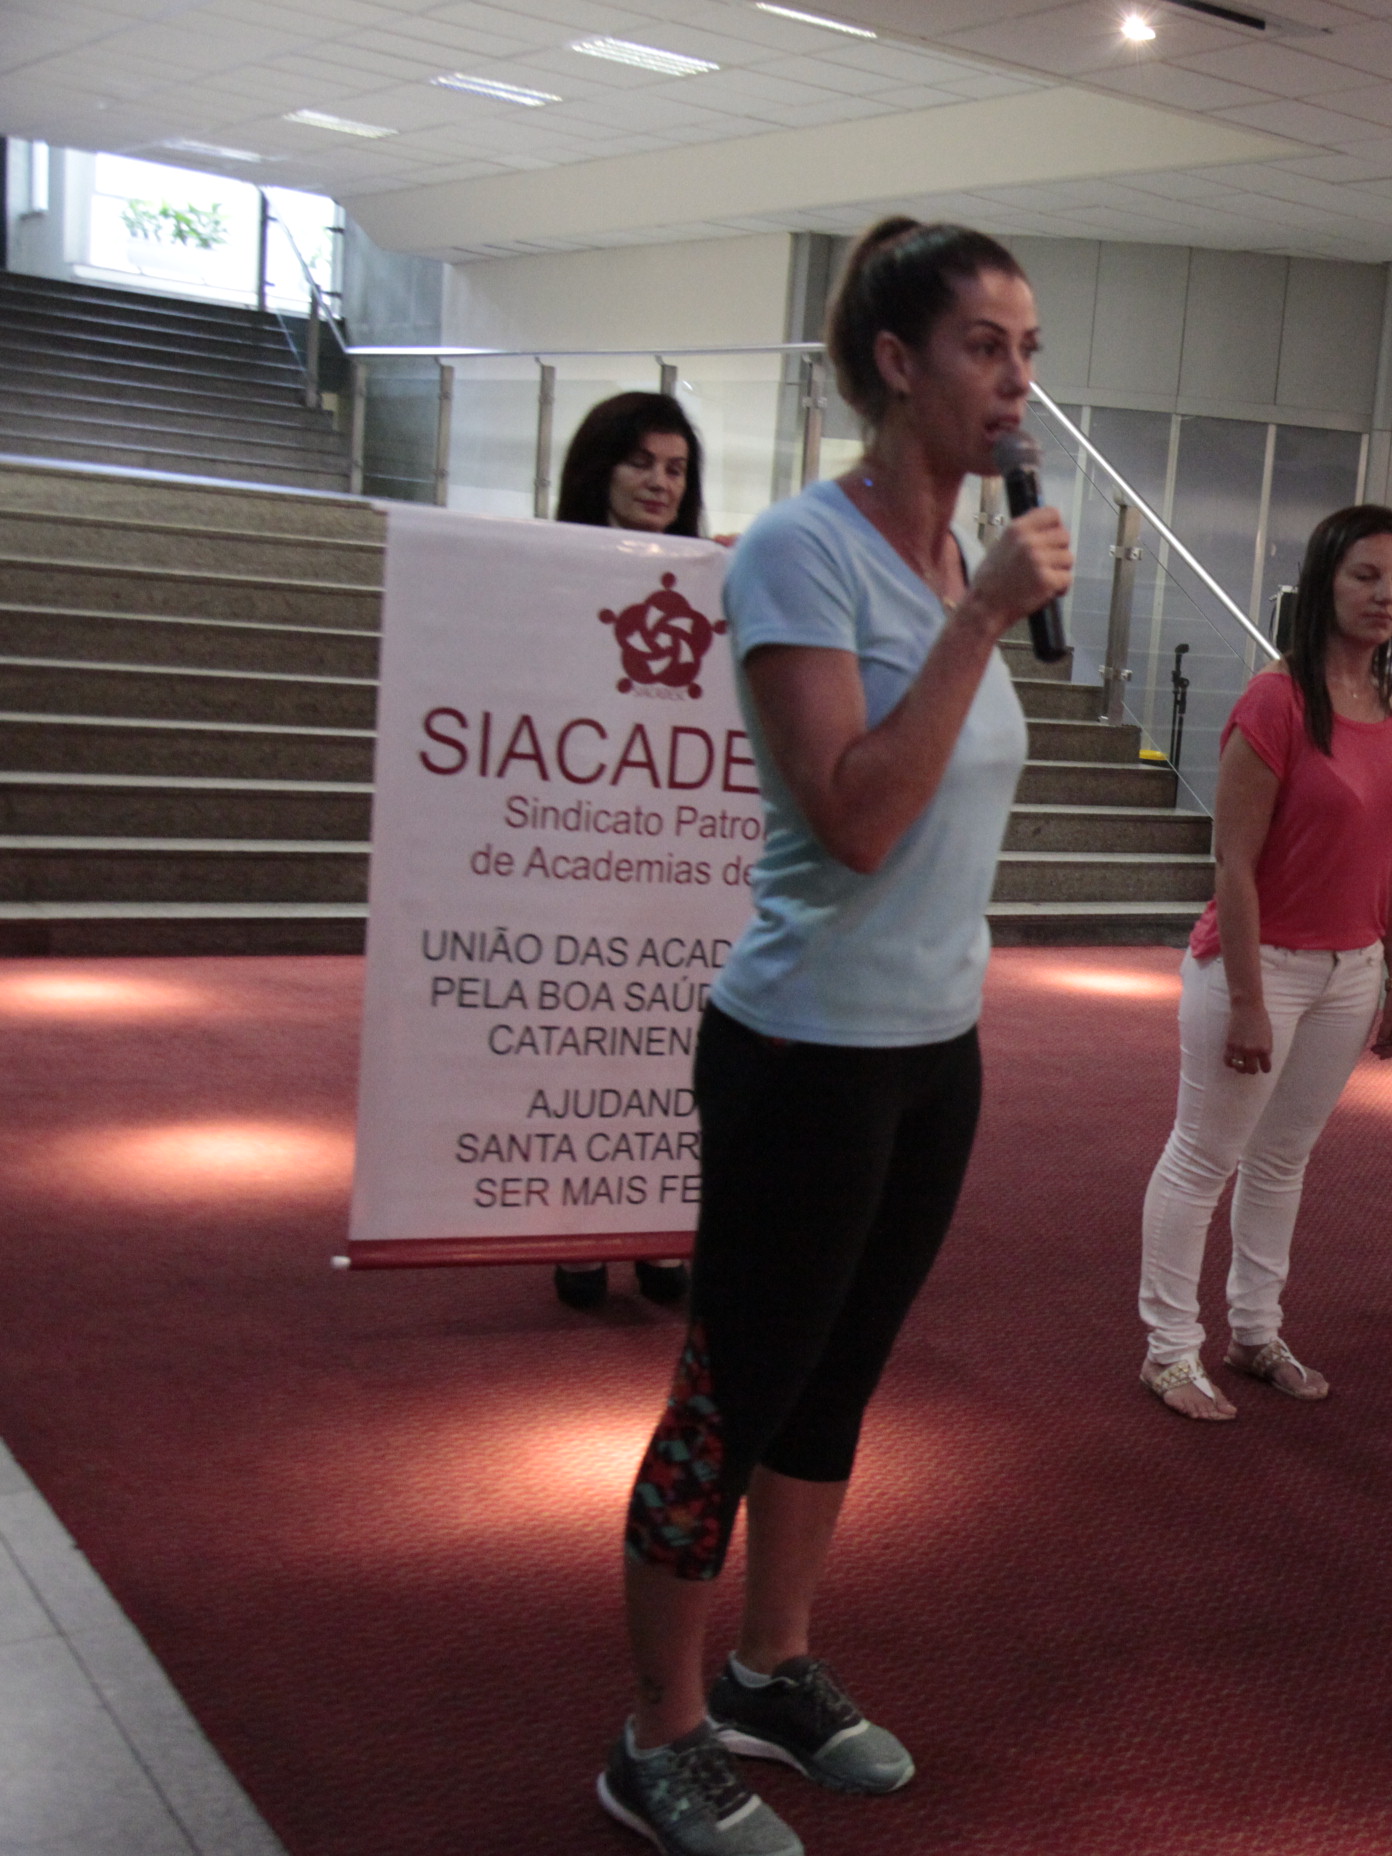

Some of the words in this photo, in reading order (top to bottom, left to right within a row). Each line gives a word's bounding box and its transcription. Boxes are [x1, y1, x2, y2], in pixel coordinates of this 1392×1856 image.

[504, 796, 664, 837] Sindicato
[674, 805, 767, 841] Patro
[470, 844, 515, 879] de
[525, 846, 712, 886] Academias
[422, 926, 543, 965] UNIÃO
[555, 935, 629, 968] DAS
[431, 976, 527, 1010] PELA
[538, 980, 615, 1012] BOA
[488, 1023, 699, 1057] CATARINEN
[456, 1132, 577, 1164] SANTA
[586, 1130, 702, 1163] CATAR
[474, 1177, 550, 1208] SER
[561, 1175, 648, 1206] MAIS
